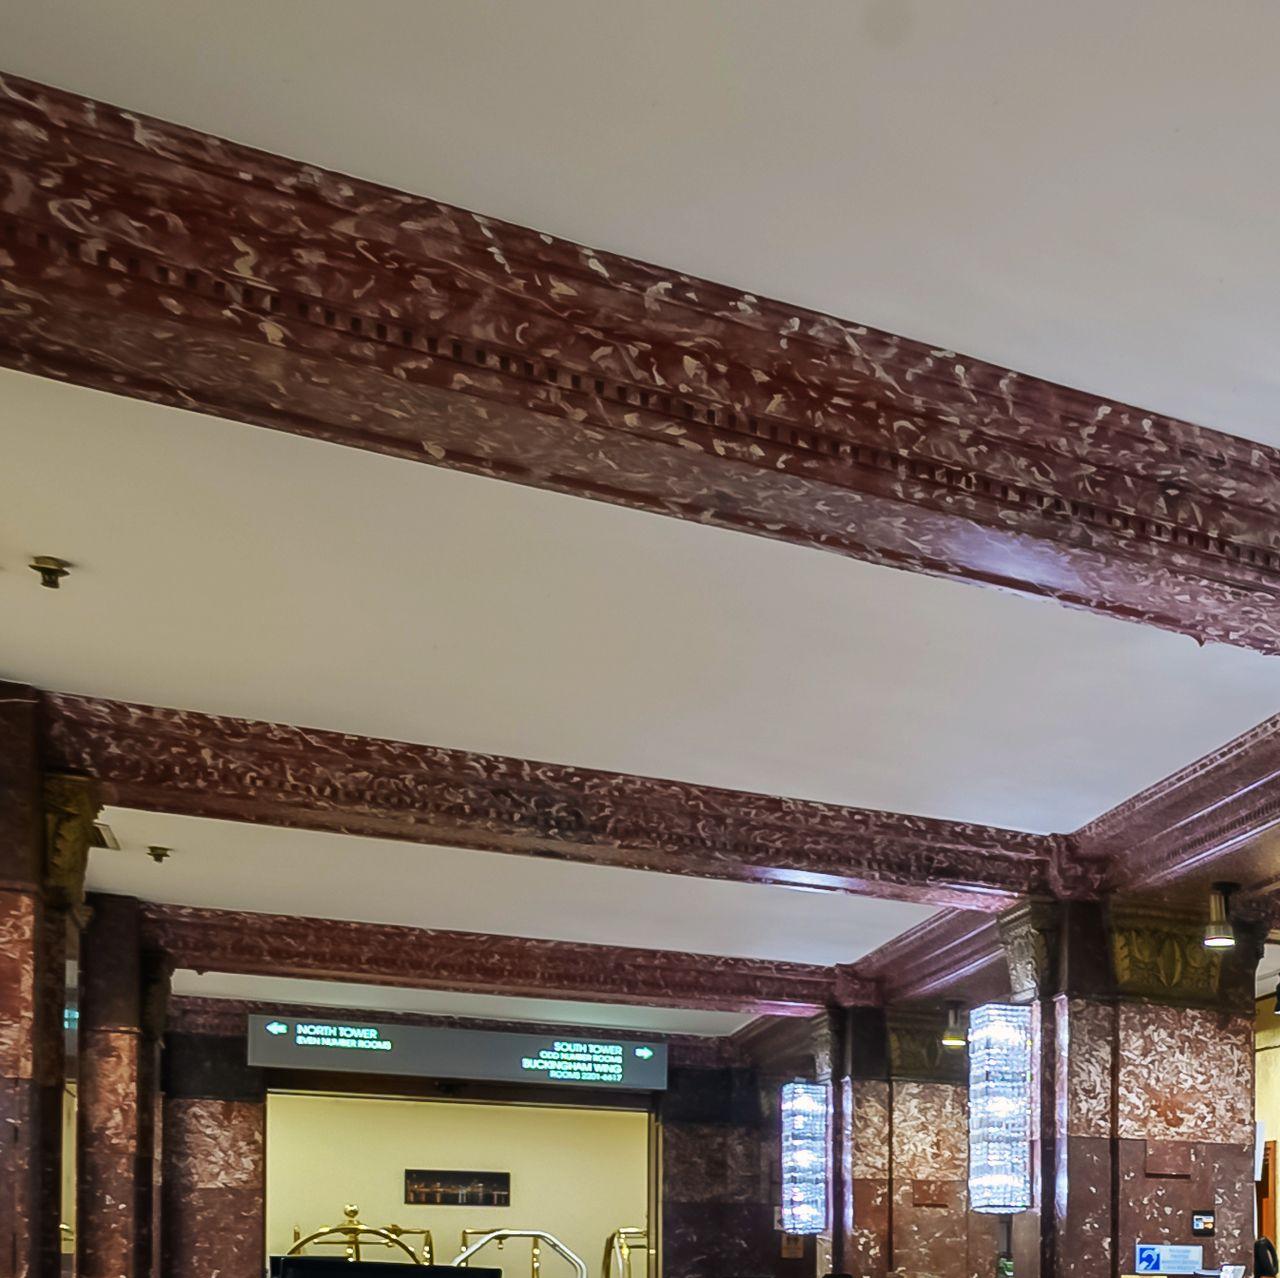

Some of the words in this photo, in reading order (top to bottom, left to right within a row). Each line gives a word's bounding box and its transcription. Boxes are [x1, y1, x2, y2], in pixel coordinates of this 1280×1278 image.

[296, 1024, 337, 1036] NORTH
[339, 1026, 378, 1039] TOWER
[296, 1036, 320, 1045] EVEN
[321, 1038, 356, 1048] NUMBER
[358, 1040, 391, 1050] ROOMS
[553, 1042, 587, 1053] SOUTH
[588, 1044, 622, 1055] TOWER
[539, 1050, 559, 1059] ODD
[592, 1054, 622, 1063] ROOMS
[522, 1057, 592, 1072] BUCKINGHAM
[593, 1063, 622, 1074] WING
[549, 1070, 580, 1079] ROOMS
